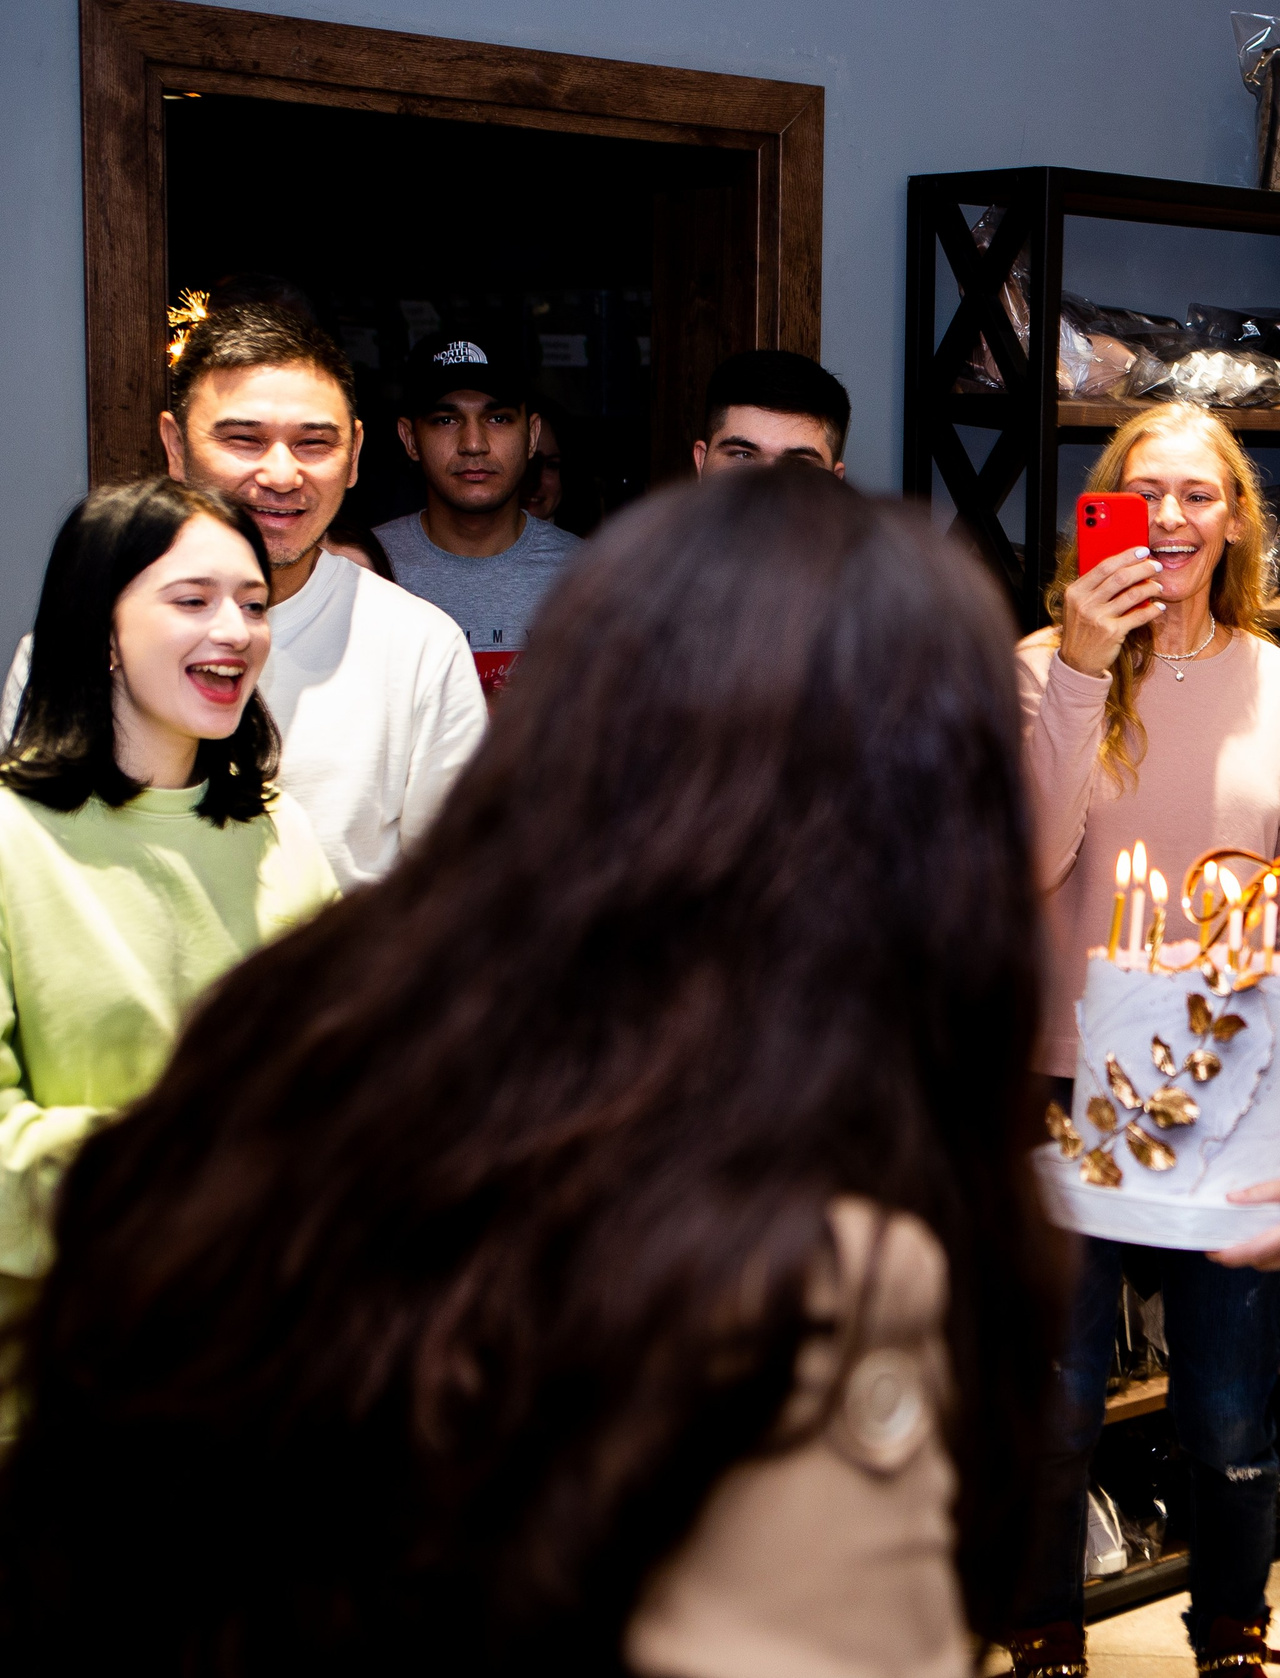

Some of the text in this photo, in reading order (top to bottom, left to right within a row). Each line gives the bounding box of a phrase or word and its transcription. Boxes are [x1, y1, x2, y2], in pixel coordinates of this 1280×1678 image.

[447, 341, 469, 350] THE
[433, 348, 468, 362] NORTH
[442, 355, 469, 366] FACE
